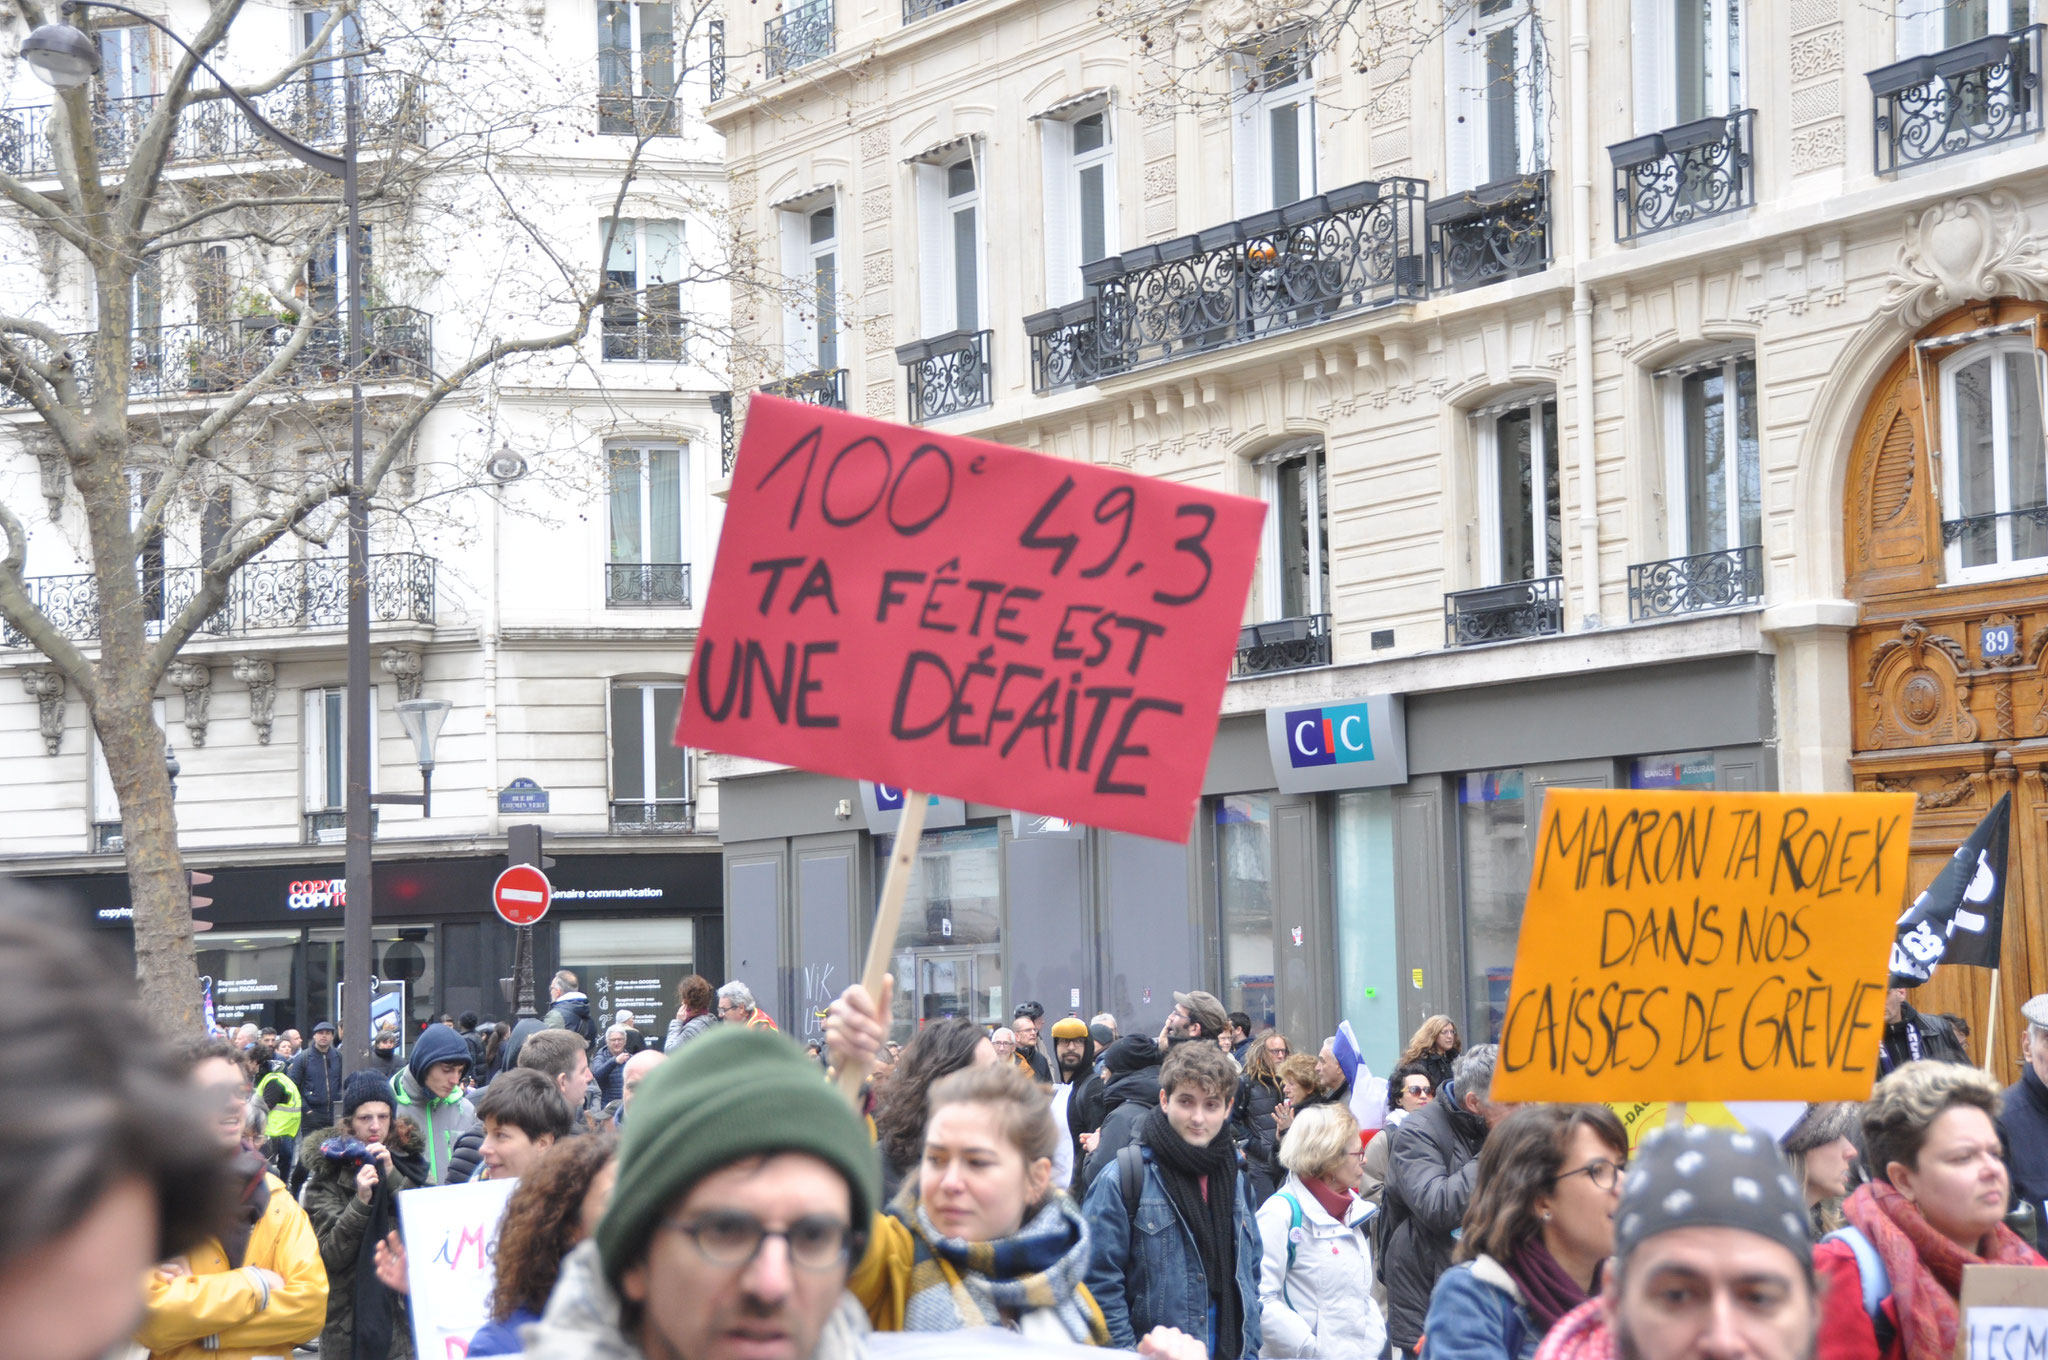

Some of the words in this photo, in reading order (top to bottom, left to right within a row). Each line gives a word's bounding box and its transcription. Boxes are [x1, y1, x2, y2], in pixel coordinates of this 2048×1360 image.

[749, 556, 839, 616] TA
[876, 558, 1043, 645] FÊTE
[1052, 605, 1166, 676] EST
[1985, 630, 2009, 652] 89
[697, 638, 840, 728] UNE
[1295, 715, 1364, 756] CIC
[1644, 768, 1672, 778] BANQUE
[1538, 806, 1714, 891] MACRON
[1724, 808, 1762, 880] TA
[1770, 808, 1900, 898] ROLEX
[551, 889, 585, 898] enaire
[586, 888, 663, 898] communication
[1600, 896, 1724, 969] DANS
[1737, 905, 1810, 965] NOS
[1675, 988, 1733, 1066] DE
[1739, 968, 1884, 1072] GRÈVE
